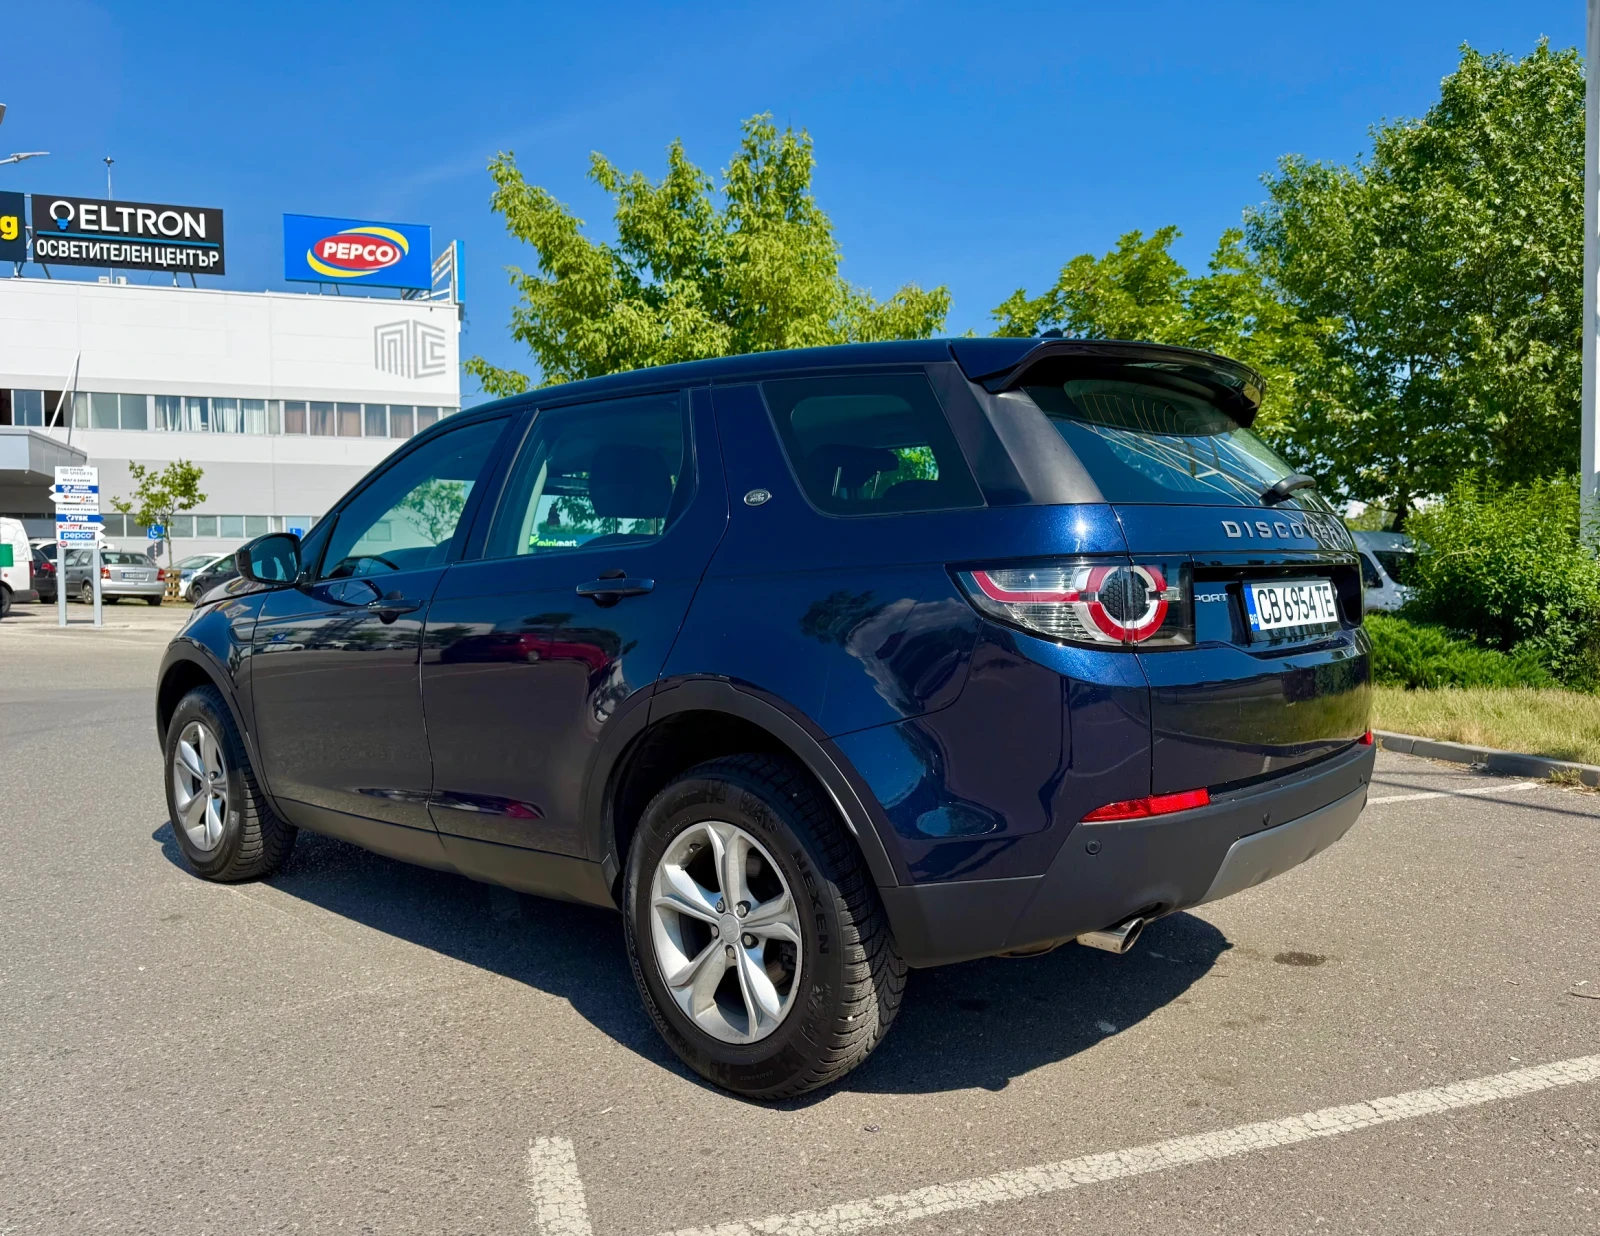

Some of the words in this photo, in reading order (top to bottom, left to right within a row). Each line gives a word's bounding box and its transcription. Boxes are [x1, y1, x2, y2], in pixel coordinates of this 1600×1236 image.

[0, 215, 18, 240] g
[79, 204, 206, 239] ELTRON
[36, 239, 151, 263] ОСВЕТИТЕЛЕН
[155, 246, 219, 267] ЦЕНТЪР
[323, 242, 394, 262] PEPCO
[537, 538, 577, 547] minimart
[1194, 593, 1228, 602] PORT
[1257, 588, 1282, 624] CB
[1283, 586, 1317, 621] 6954
[1316, 585, 1335, 618] TE
[1249, 613, 1259, 625] BG
[791, 849, 830, 954] NEXEN
